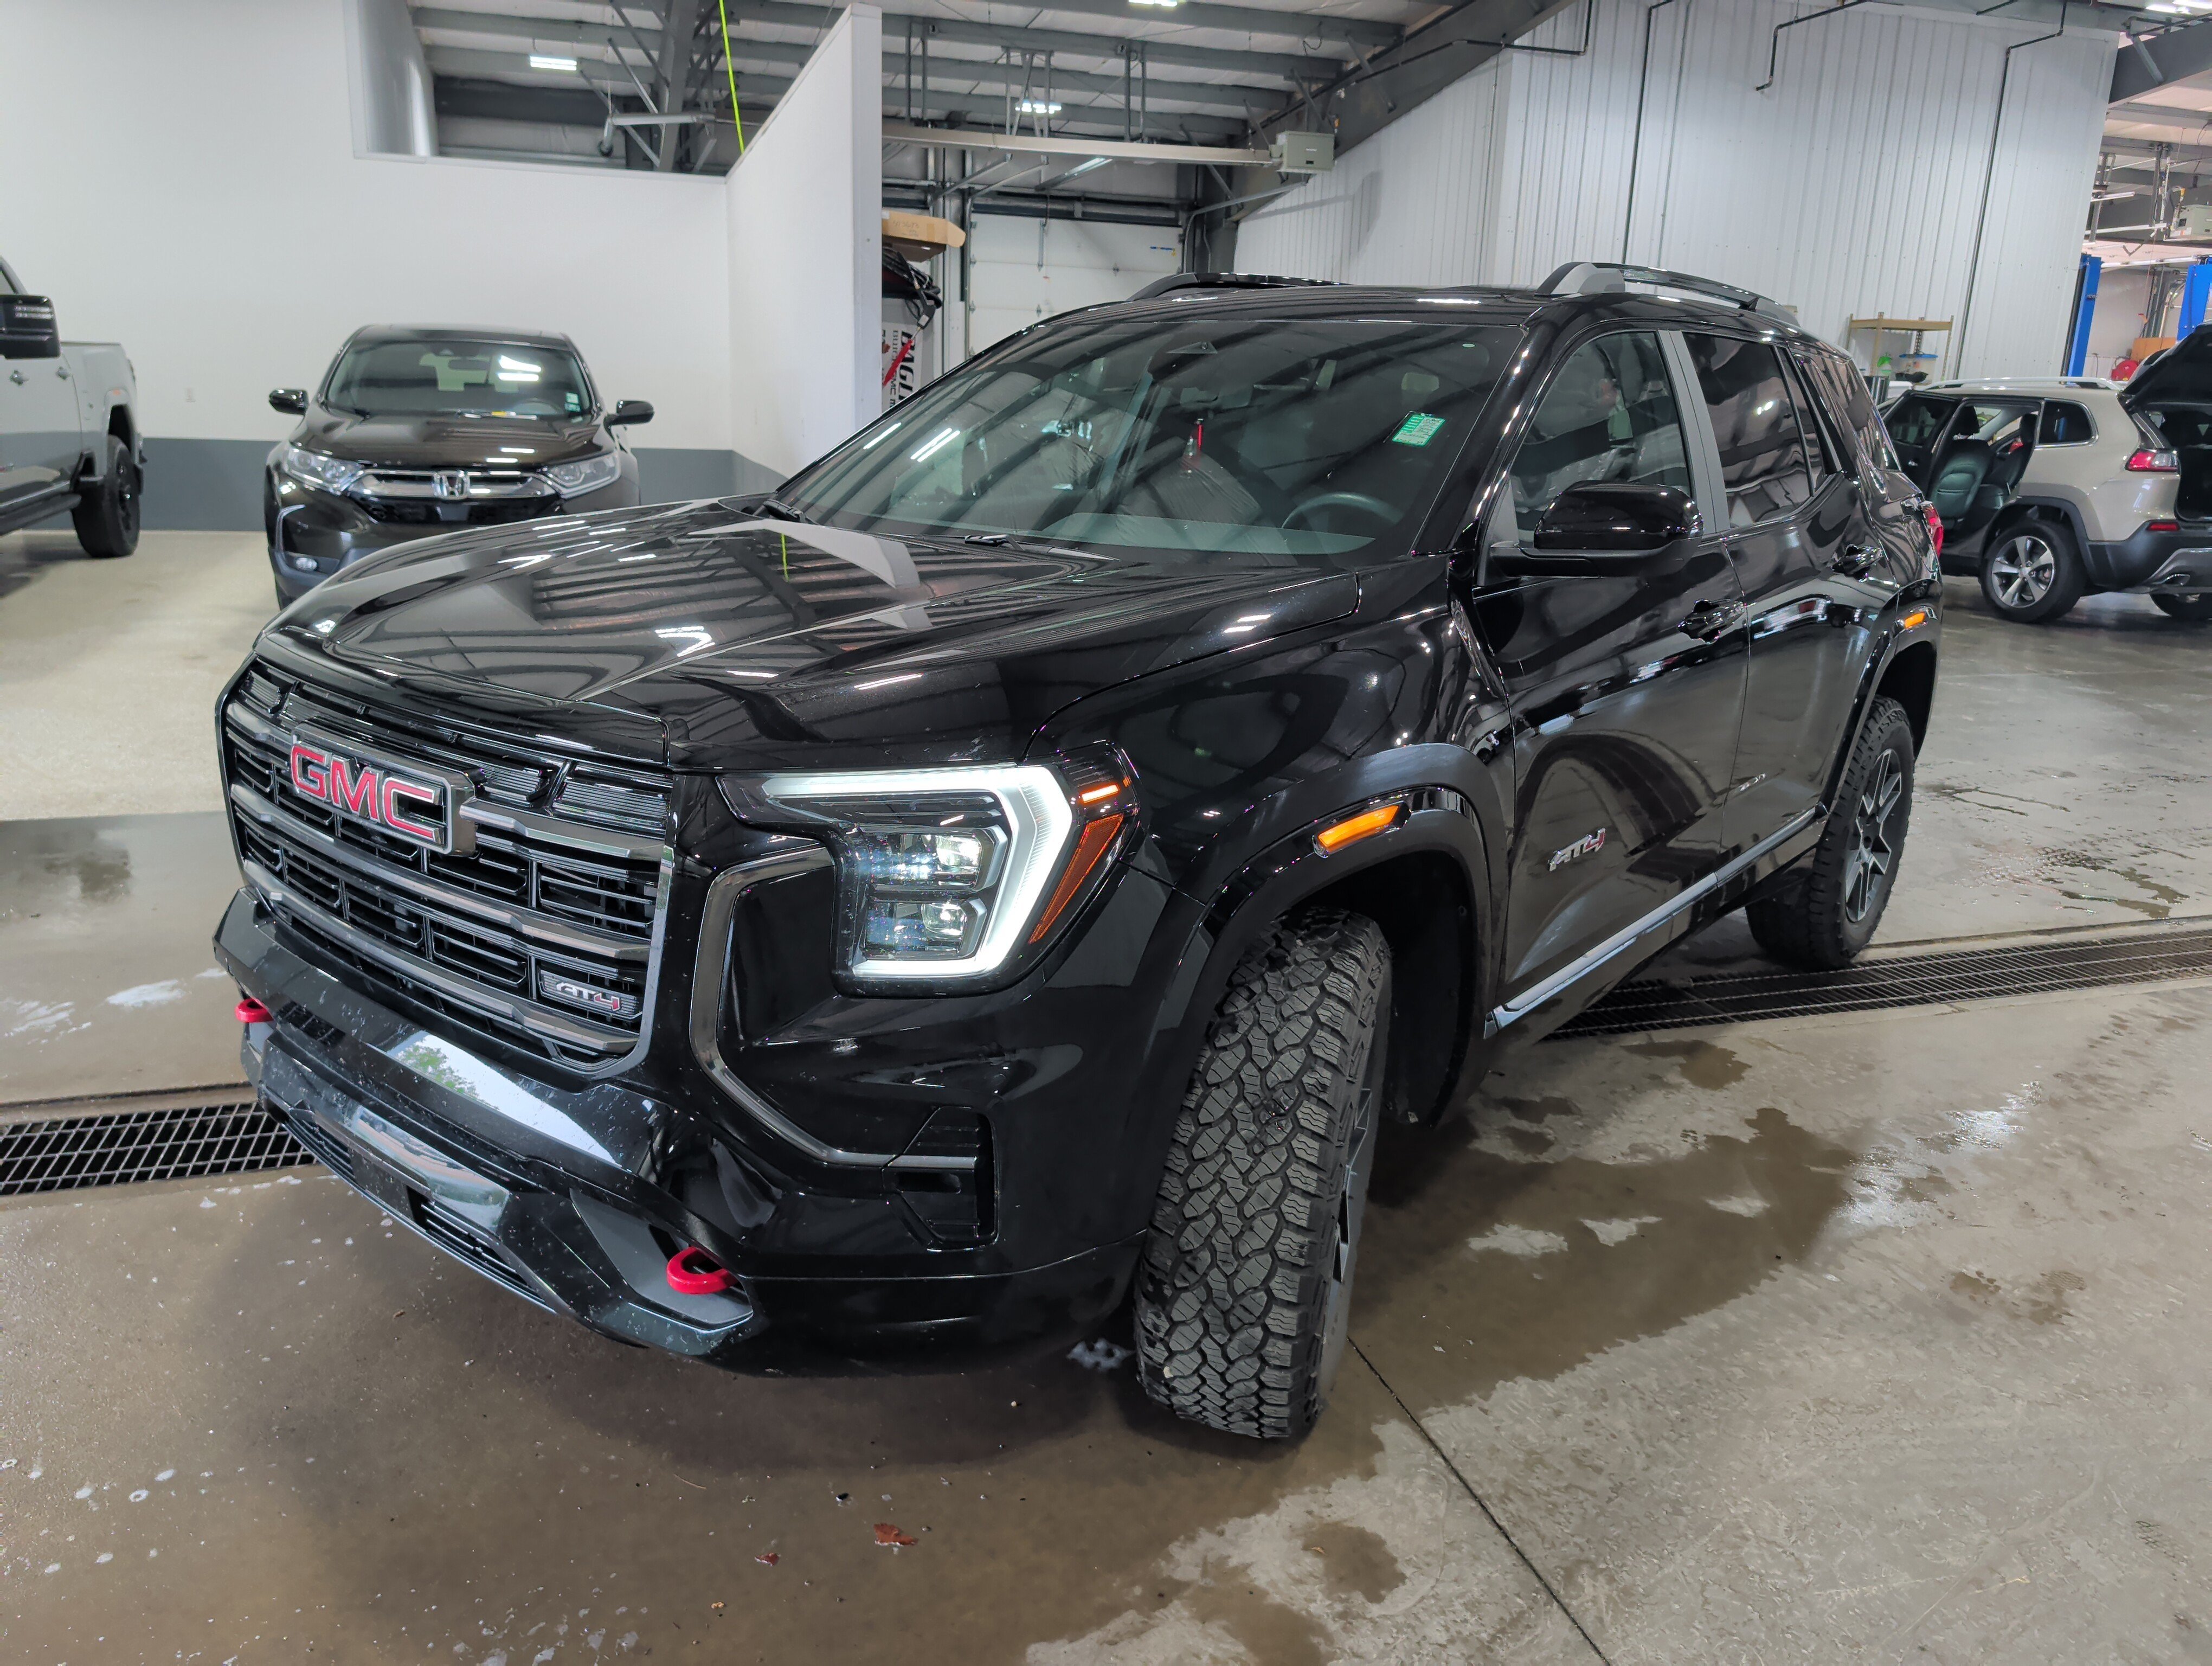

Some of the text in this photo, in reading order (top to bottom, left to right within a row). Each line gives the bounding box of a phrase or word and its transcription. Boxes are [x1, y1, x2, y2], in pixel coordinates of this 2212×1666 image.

[291, 743, 442, 844] GMC
[1548, 828, 1606, 872] AT4
[556, 982, 620, 1012] AT4
